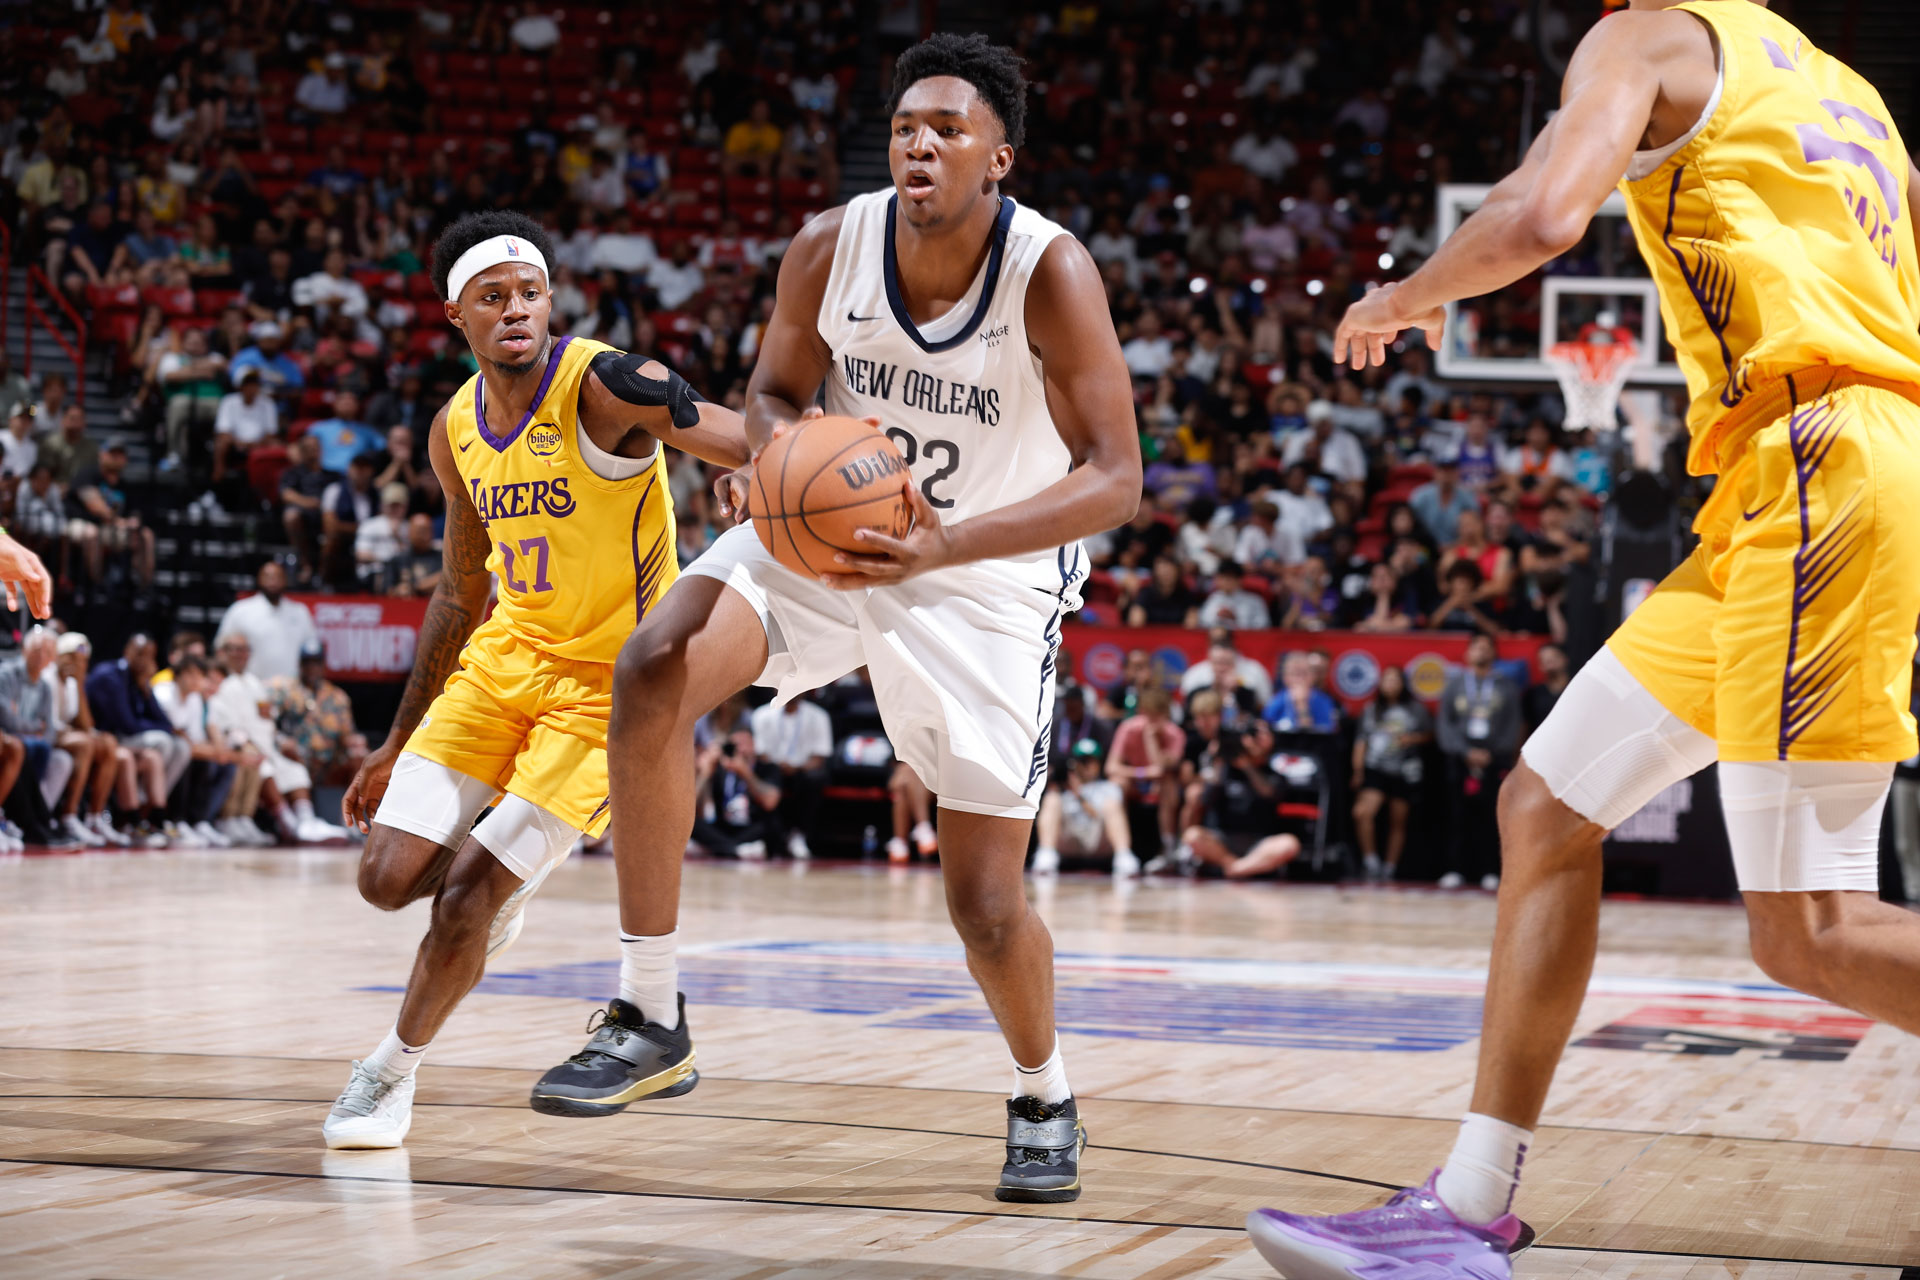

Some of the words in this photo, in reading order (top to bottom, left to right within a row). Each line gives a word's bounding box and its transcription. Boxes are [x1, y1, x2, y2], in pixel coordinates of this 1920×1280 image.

[844, 354, 898, 400] NEW
[903, 369, 1001, 426] ORLEANS
[530, 431, 561, 446] bibigo
[836, 449, 910, 491] Wilso
[470, 477, 577, 528] LAKERS
